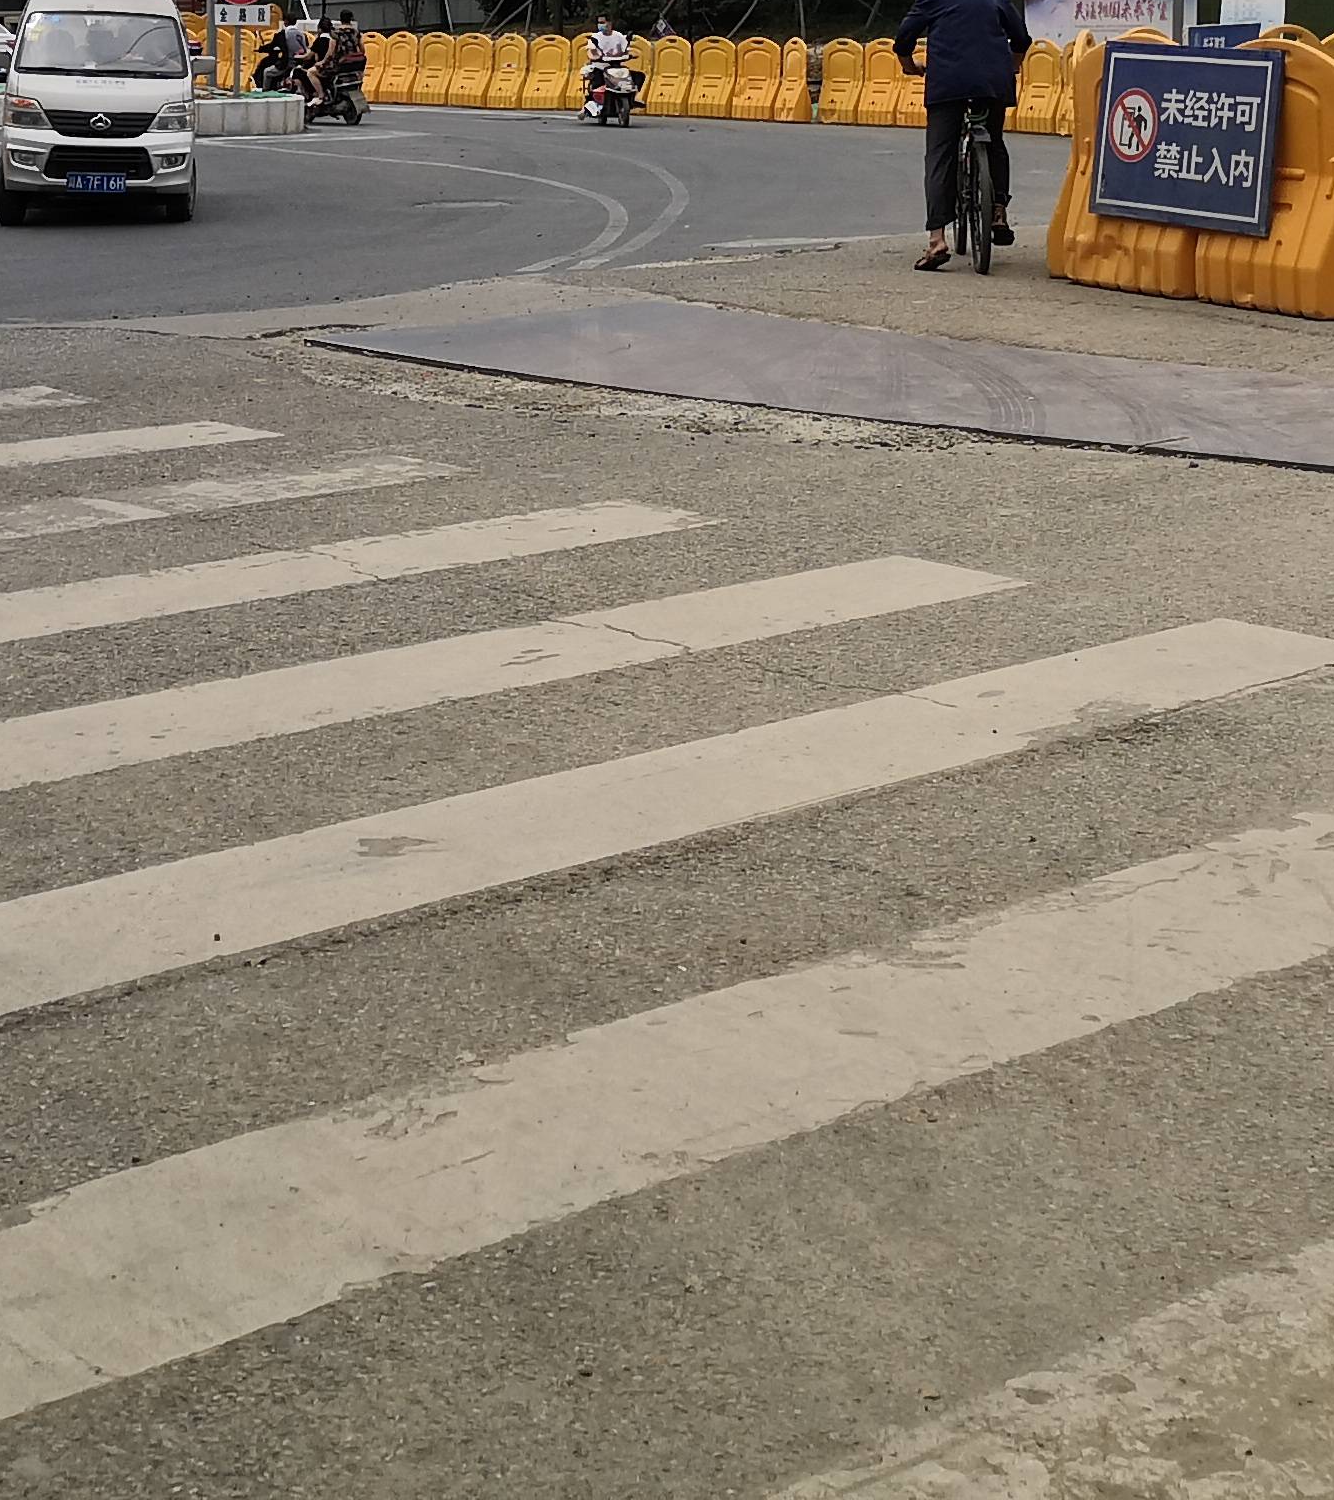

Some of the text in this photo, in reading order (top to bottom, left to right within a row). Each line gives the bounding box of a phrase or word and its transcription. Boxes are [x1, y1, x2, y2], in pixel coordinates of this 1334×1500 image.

[1160, 89, 1261, 132] 未经许可
[1154, 141, 1255, 188] 禁止入内
